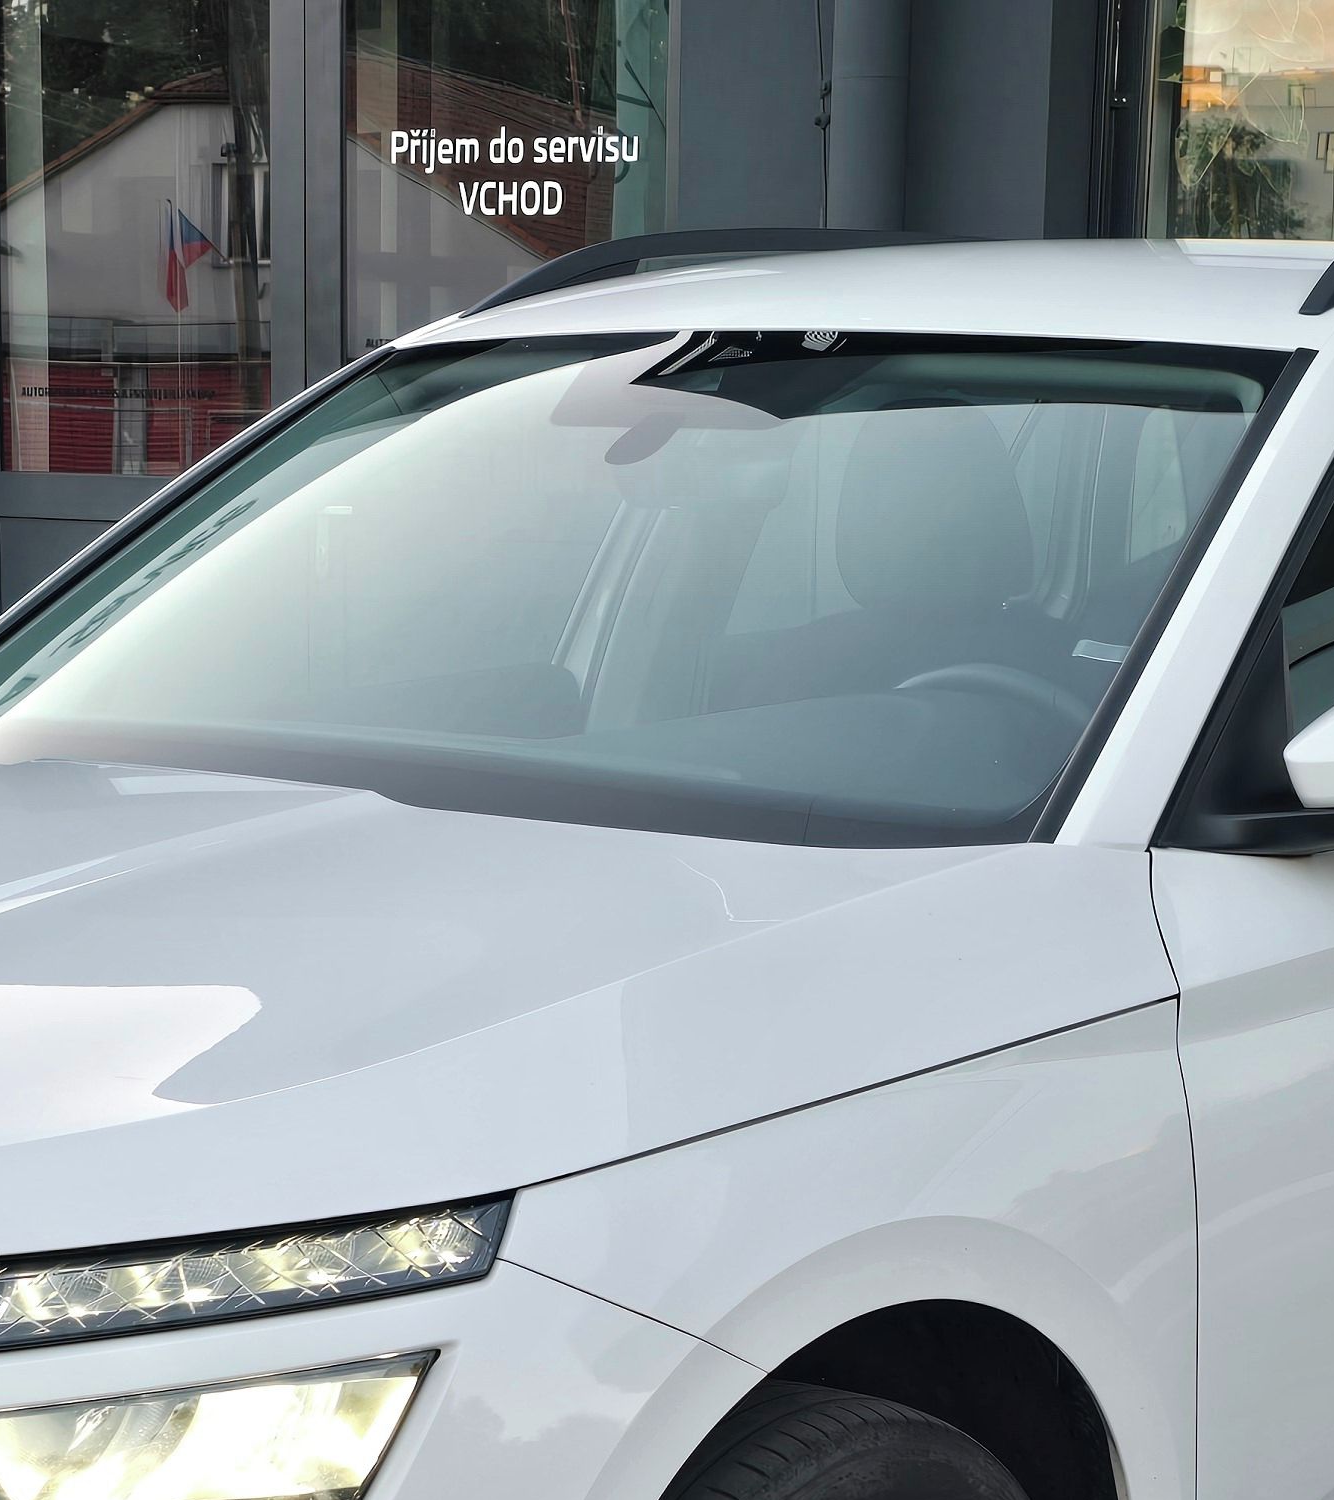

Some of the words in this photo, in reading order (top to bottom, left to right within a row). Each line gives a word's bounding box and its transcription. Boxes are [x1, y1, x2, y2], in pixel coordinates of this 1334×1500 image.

[390, 128, 480, 174] Příjem
[489, 125, 525, 164] do
[532, 125, 640, 163] servisu
[458, 180, 564, 216] VCHOD
